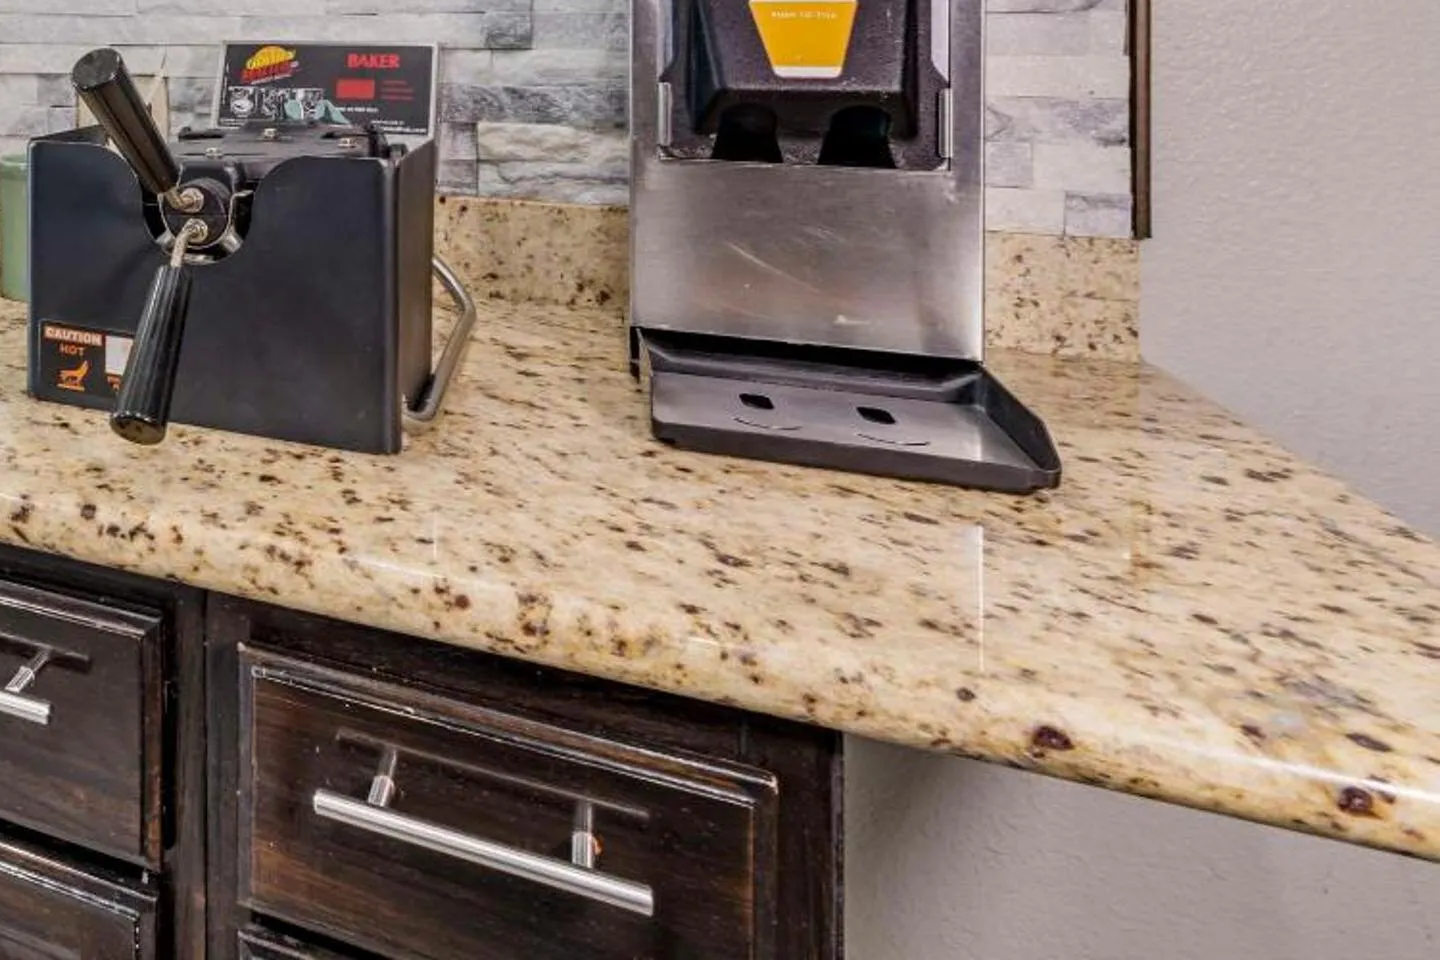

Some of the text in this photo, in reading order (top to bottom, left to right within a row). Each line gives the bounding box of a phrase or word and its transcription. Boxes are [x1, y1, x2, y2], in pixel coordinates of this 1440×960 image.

[346, 53, 400, 69] BAKER
[44, 325, 103, 346] CAUTION
[59, 343, 85, 356] HOT
